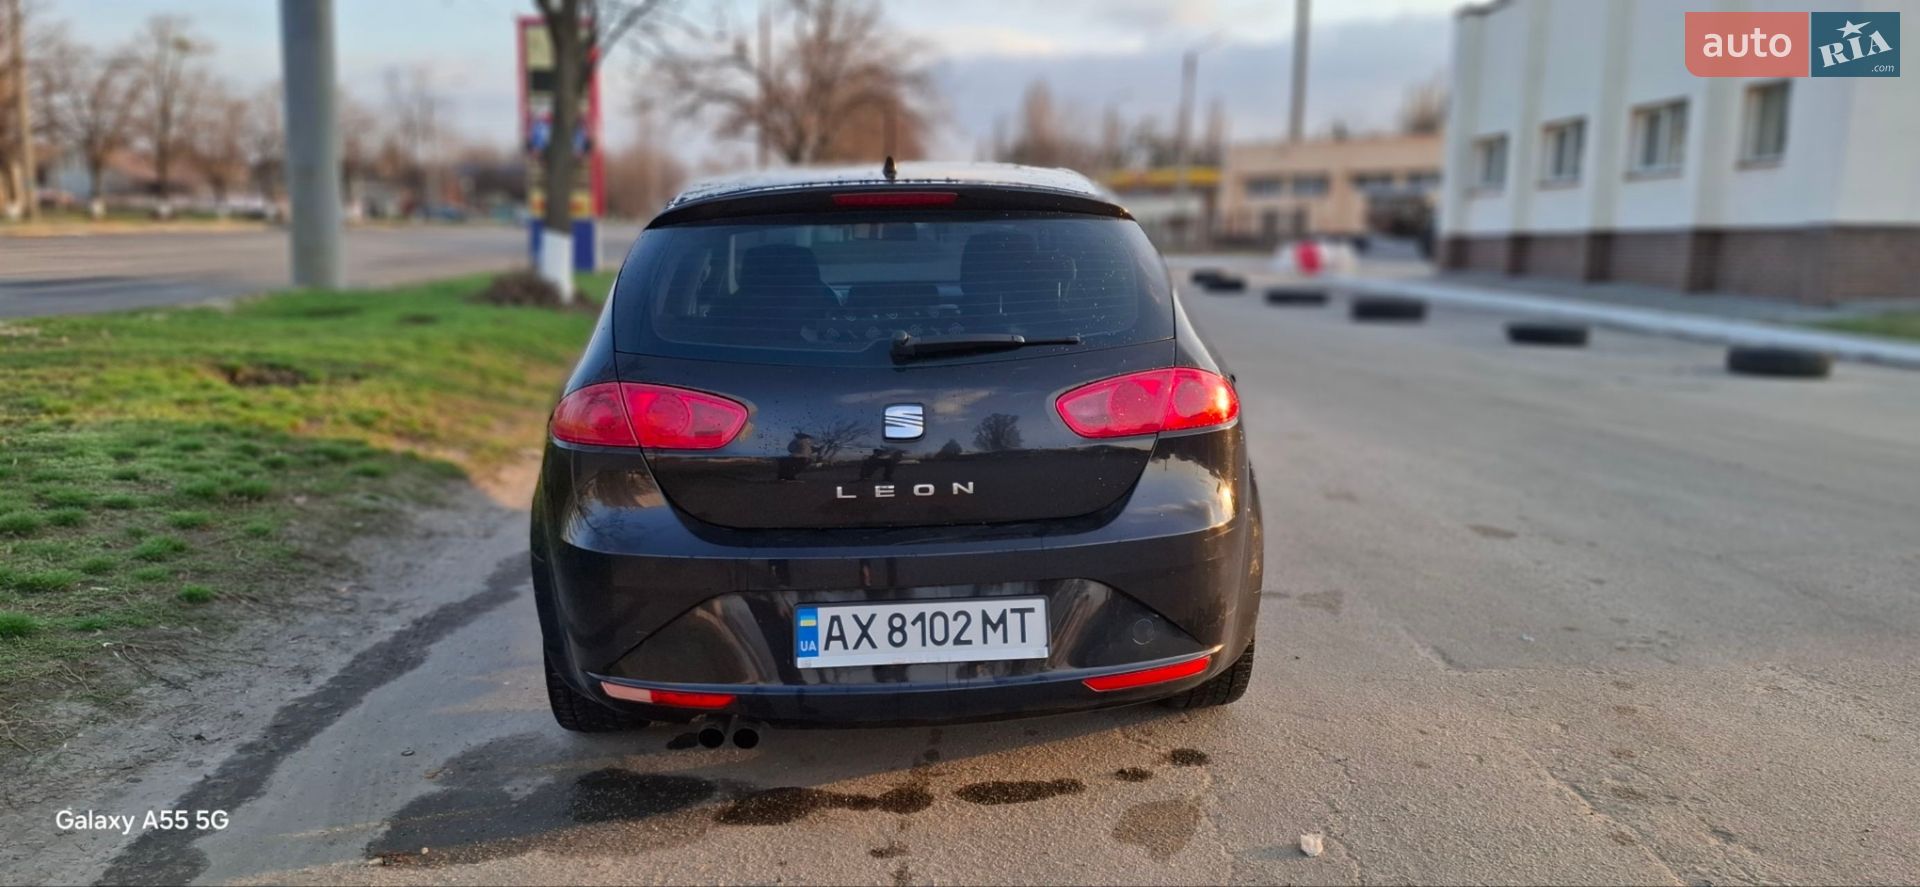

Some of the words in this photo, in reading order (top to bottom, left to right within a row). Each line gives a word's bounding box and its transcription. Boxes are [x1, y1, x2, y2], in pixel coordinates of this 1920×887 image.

[836, 481, 974, 499] LEON
[823, 613, 878, 651] AX
[887, 610, 973, 648] 8102
[981, 607, 1036, 645] MT
[800, 640, 817, 652] UA
